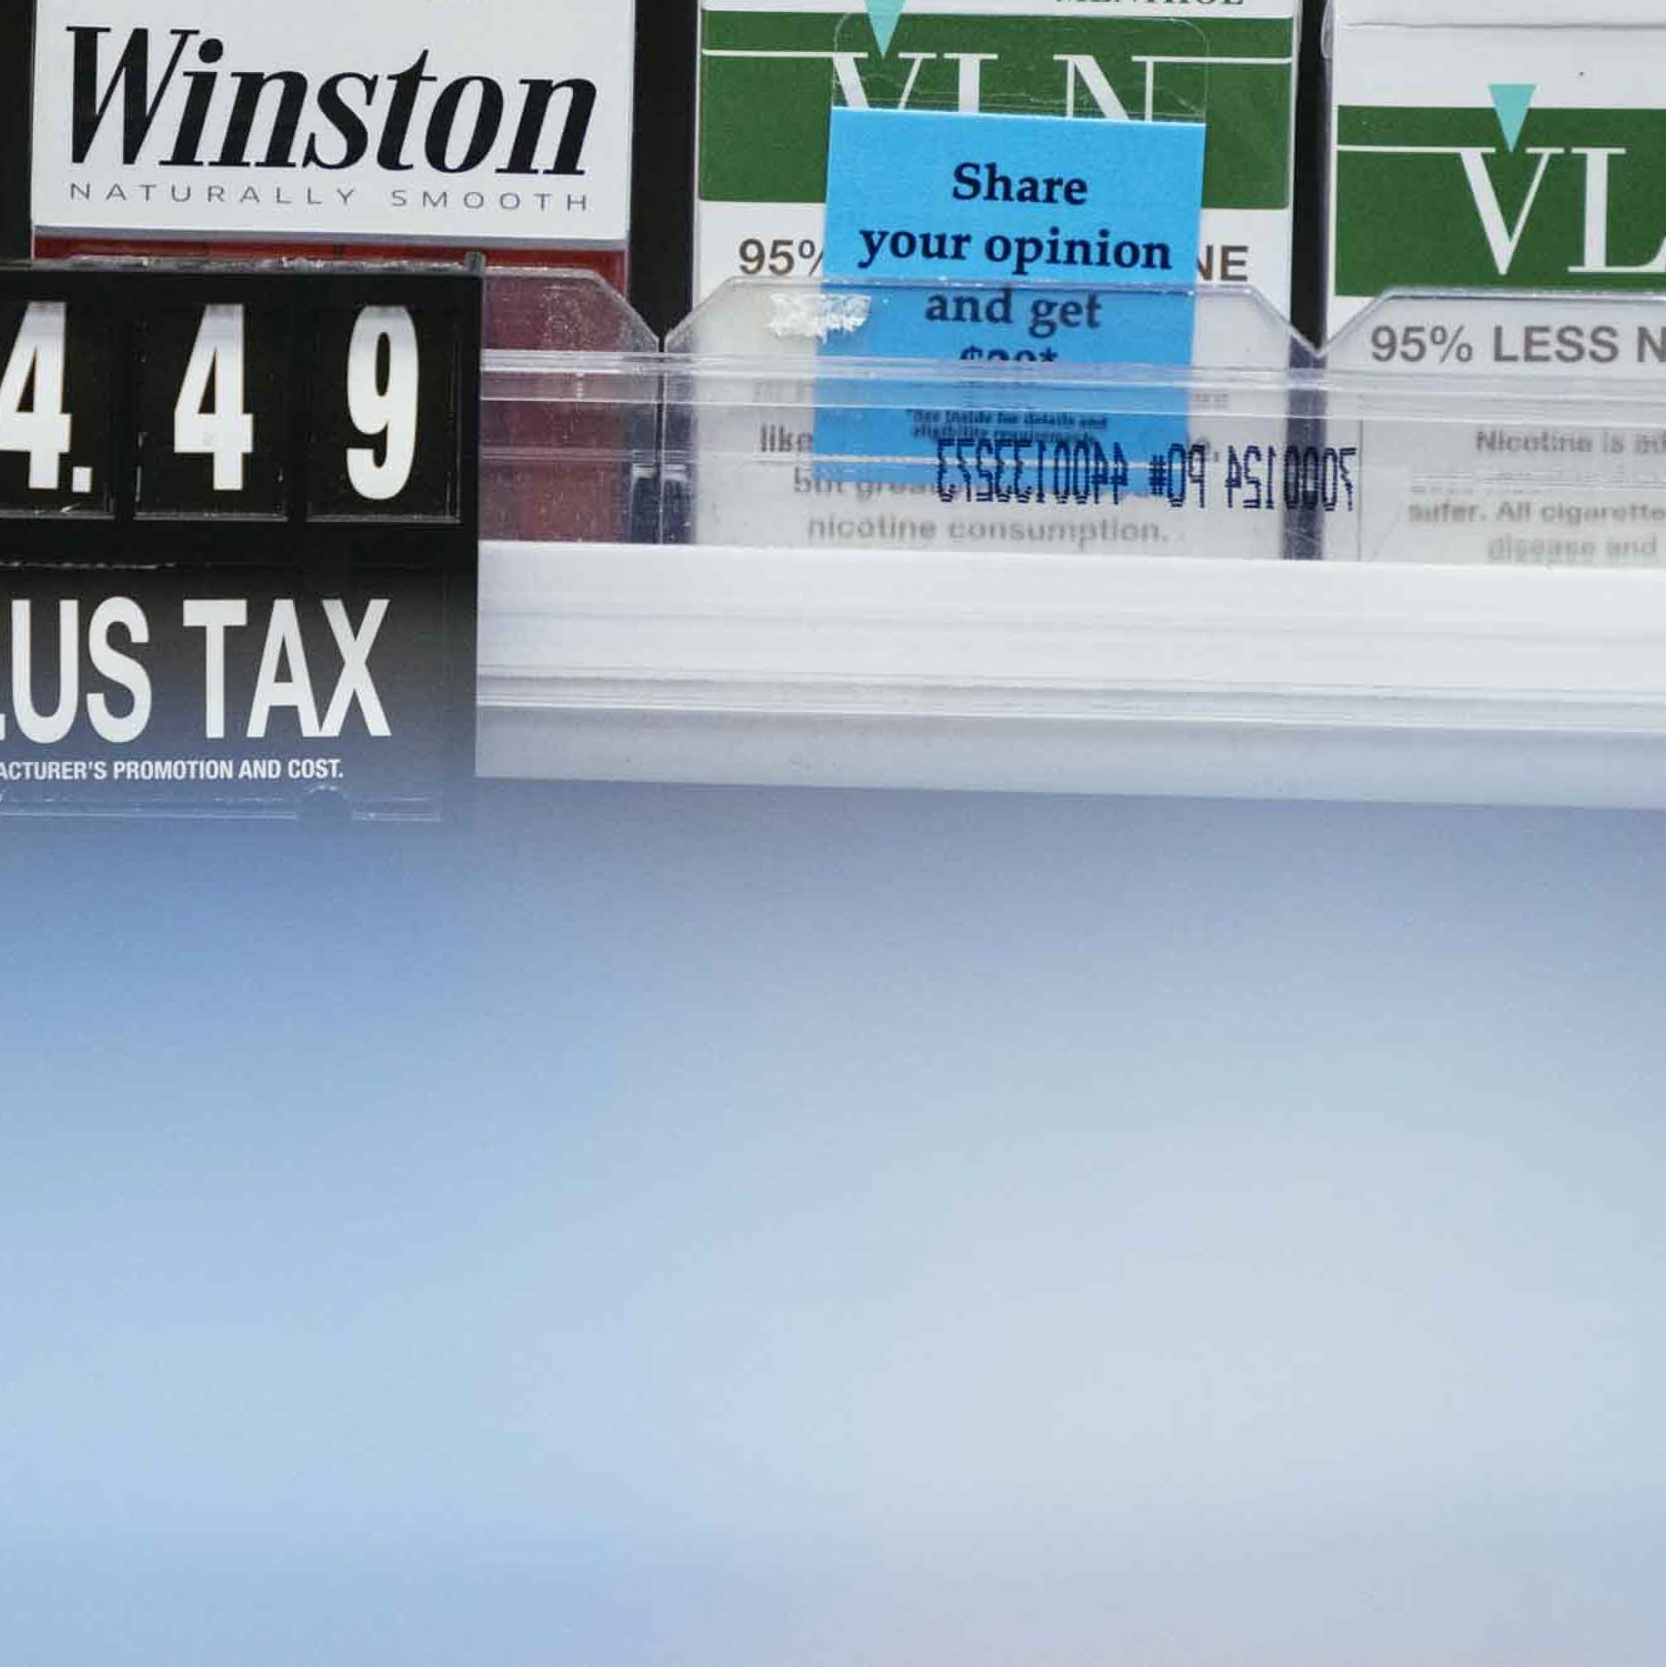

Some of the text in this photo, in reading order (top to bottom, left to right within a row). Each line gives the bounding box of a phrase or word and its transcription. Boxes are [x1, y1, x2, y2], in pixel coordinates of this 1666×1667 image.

[65, 25, 599, 176] Winston
[70, 182, 591, 212] NATURALLY SMOOTH
[951, 161, 1089, 205] Share
[858, 227, 972, 269] your
[984, 226, 1173, 276] opinion
[925, 287, 1102, 337] and get
[1370, 324, 1473, 365] 95%
[1491, 324, 1619, 364] LESS
[181, 598, 392, 738] TAX
[113, 758, 234, 780] PROMOTION
[237, 758, 281, 779] AND
[284, 757, 344, 780] COST.
